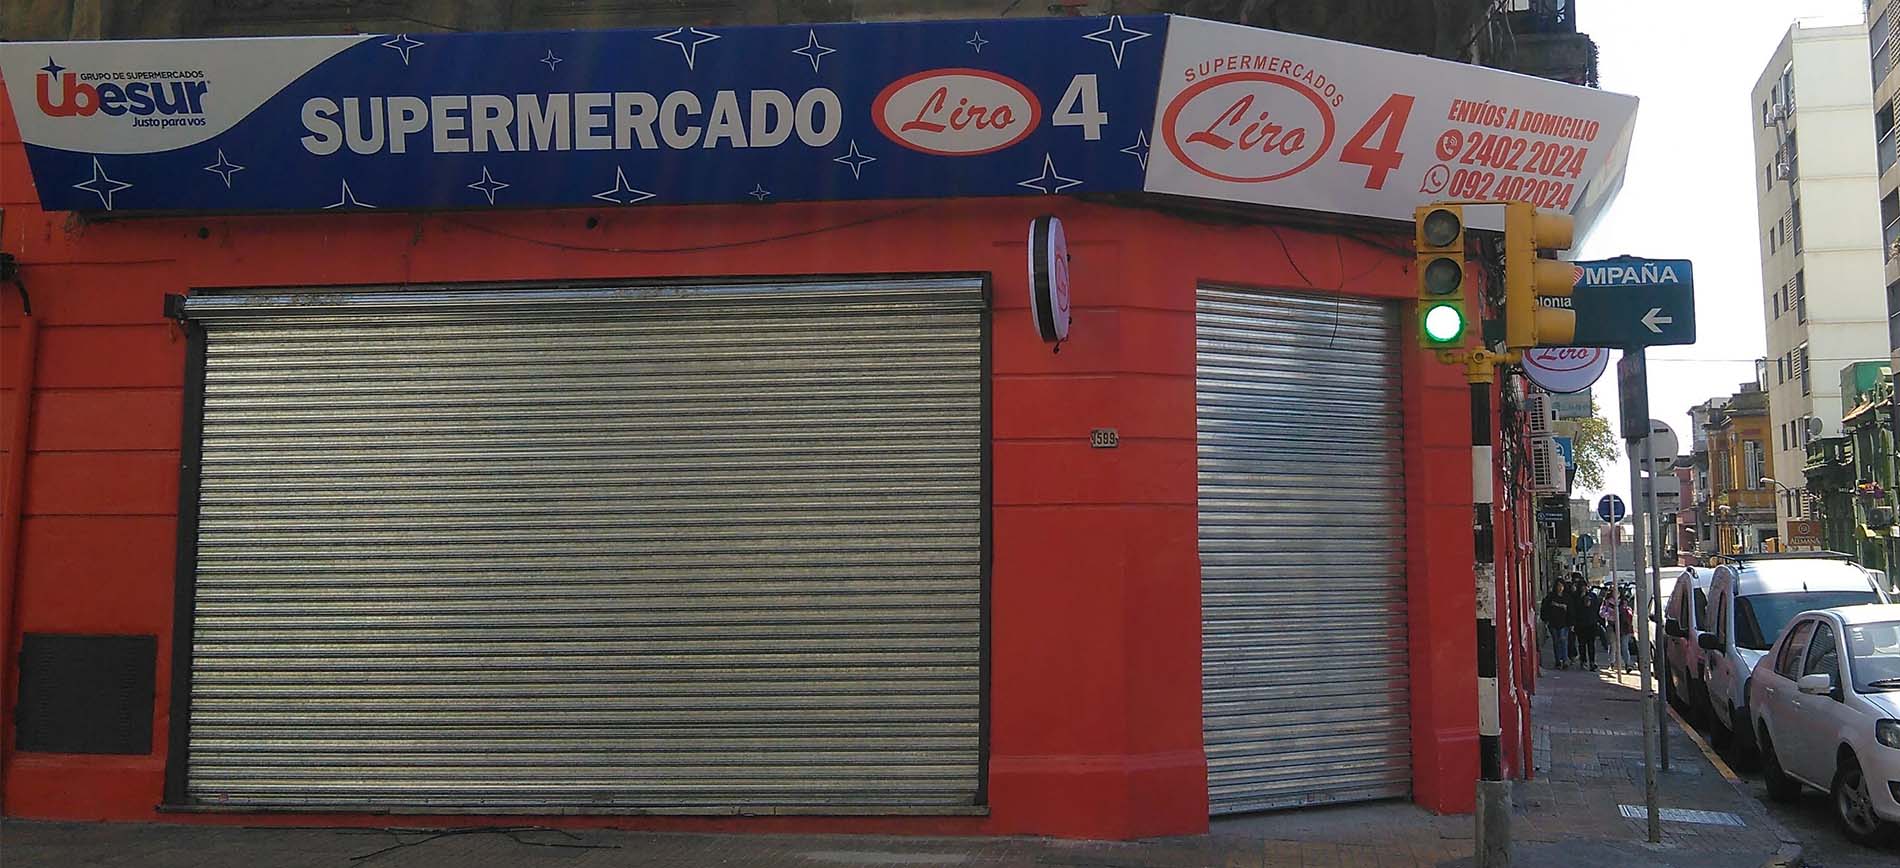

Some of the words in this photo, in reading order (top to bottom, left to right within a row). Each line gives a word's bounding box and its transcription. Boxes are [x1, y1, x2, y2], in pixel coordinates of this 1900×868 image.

[80, 72, 111, 81] GRUPO
[113, 72, 125, 80] DE
[127, 70, 204, 80] SUPERMERCADOS
[1184, 55, 1345, 108] SUPERMERCADOS
[132, 117, 160, 127] Justo
[161, 119, 186, 129] para
[188, 118, 206, 127] vos
[300, 87, 843, 155] SUPERMERCADO
[900, 86, 1016, 133] Liro
[1051, 73, 1109, 141] 4
[1447, 99, 1508, 129] ENVÍOS
[1504, 108, 1520, 130] A
[1519, 109, 1600, 143] DOMICILIO
[1184, 94, 1308, 157] Liro
[1338, 93, 1416, 190] 4
[1459, 130, 1528, 171] 2402
[1522, 140, 1589, 180] 2024
[1448, 168, 1496, 201] 092
[1492, 175, 1575, 210] 402024
